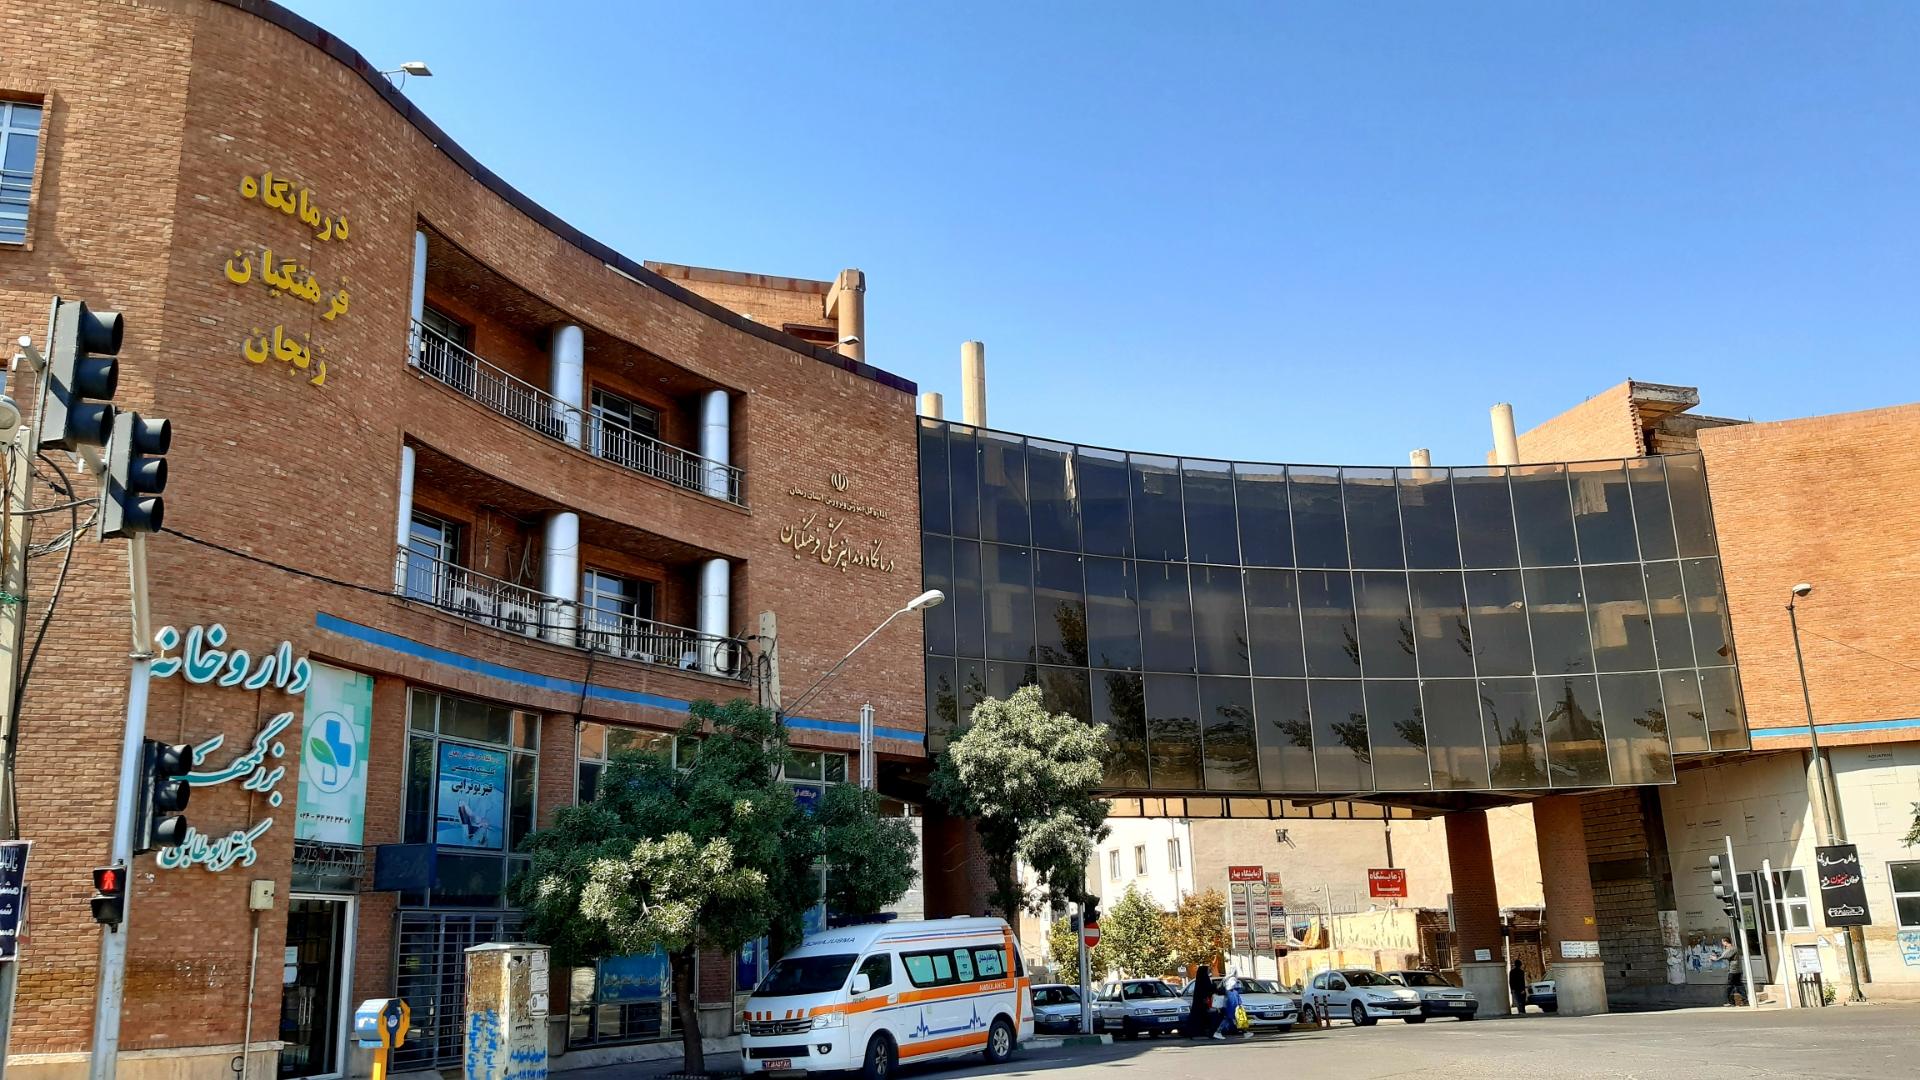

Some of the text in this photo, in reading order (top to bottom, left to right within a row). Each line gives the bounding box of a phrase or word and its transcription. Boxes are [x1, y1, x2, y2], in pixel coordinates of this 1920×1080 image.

[239, 170, 349, 242] درمانگاه
[225, 249, 349, 321] فرهنگیان
[243, 323, 327, 386] زنجان
[780, 512, 821, 560] فرهنگیان
[865, 538, 894, 573] درمانگاه
[214, 817, 273, 872] دکتر
[1370, 870, 1404, 883] آزمایشگاه
[979, 981, 1007, 991] AMBULANCE
